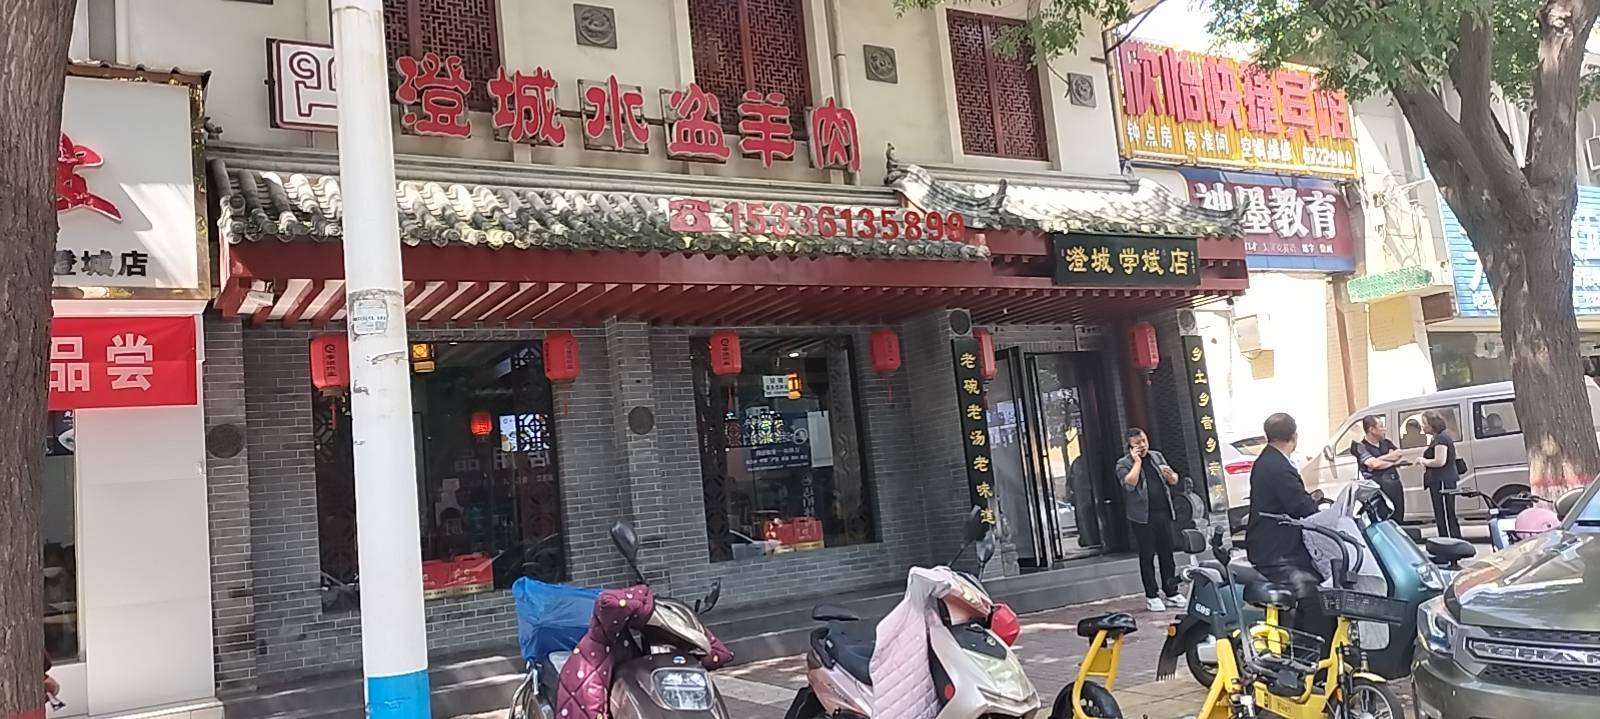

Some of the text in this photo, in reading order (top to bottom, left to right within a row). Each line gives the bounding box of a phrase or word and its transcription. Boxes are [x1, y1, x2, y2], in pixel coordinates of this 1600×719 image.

[396, 52, 861, 172] 澄城水盆羊肉
[1127, 122, 1173, 149] 钟点房
[1185, 128, 1230, 155] 标准间
[724, 201, 966, 242] 15336135899
[1066, 245, 1190, 276] 澄城学斌店
[50, 333, 153, 392] 品尝
[960, 352, 997, 525] 老碗老汤老味道
